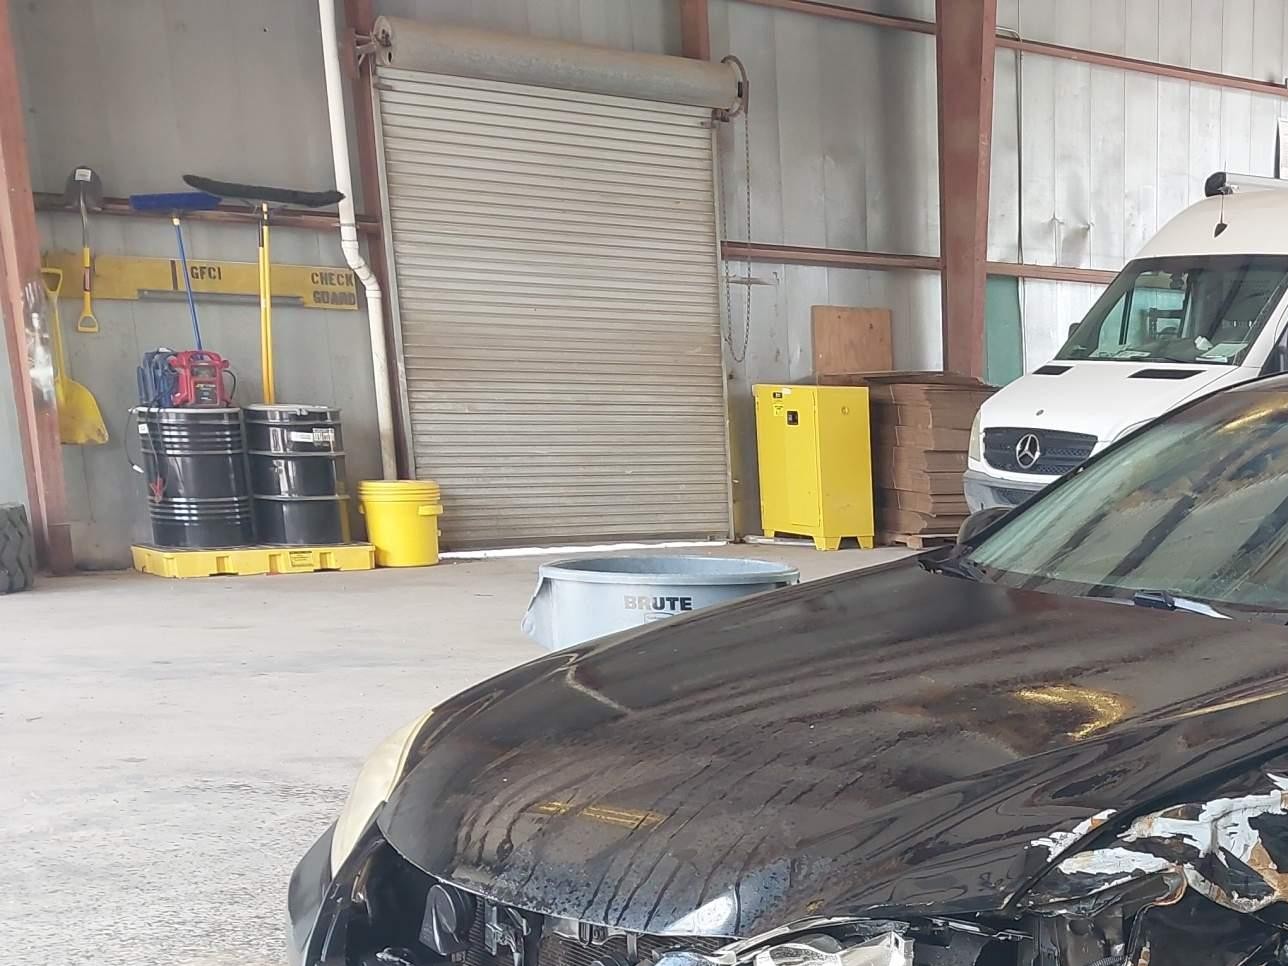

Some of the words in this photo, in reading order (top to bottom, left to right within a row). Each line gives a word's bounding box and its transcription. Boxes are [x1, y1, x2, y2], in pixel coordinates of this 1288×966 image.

[190, 266, 222, 281] GFCI
[311, 271, 354, 287] CHECK
[623, 596, 692, 611] BRUTE
